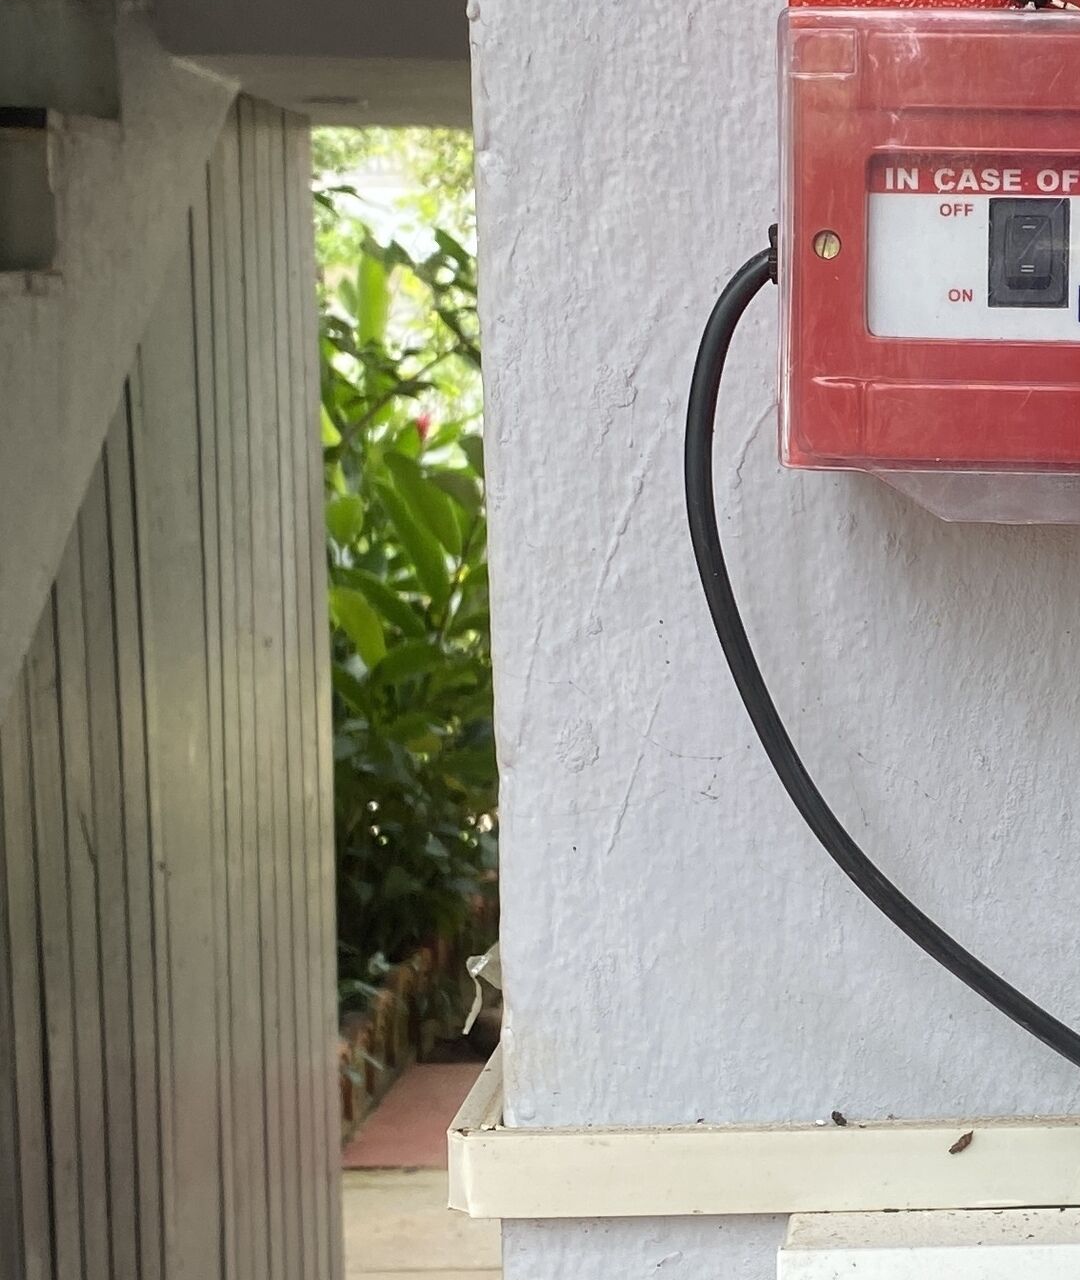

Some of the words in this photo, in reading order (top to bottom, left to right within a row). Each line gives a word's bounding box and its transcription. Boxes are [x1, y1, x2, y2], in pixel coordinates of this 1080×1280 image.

[885, 168, 919, 190] IN
[933, 168, 1022, 192] CASE
[1036, 170, 1080, 192] OF
[939, 203, 974, 217] OFF
[948, 288, 973, 303] ON
